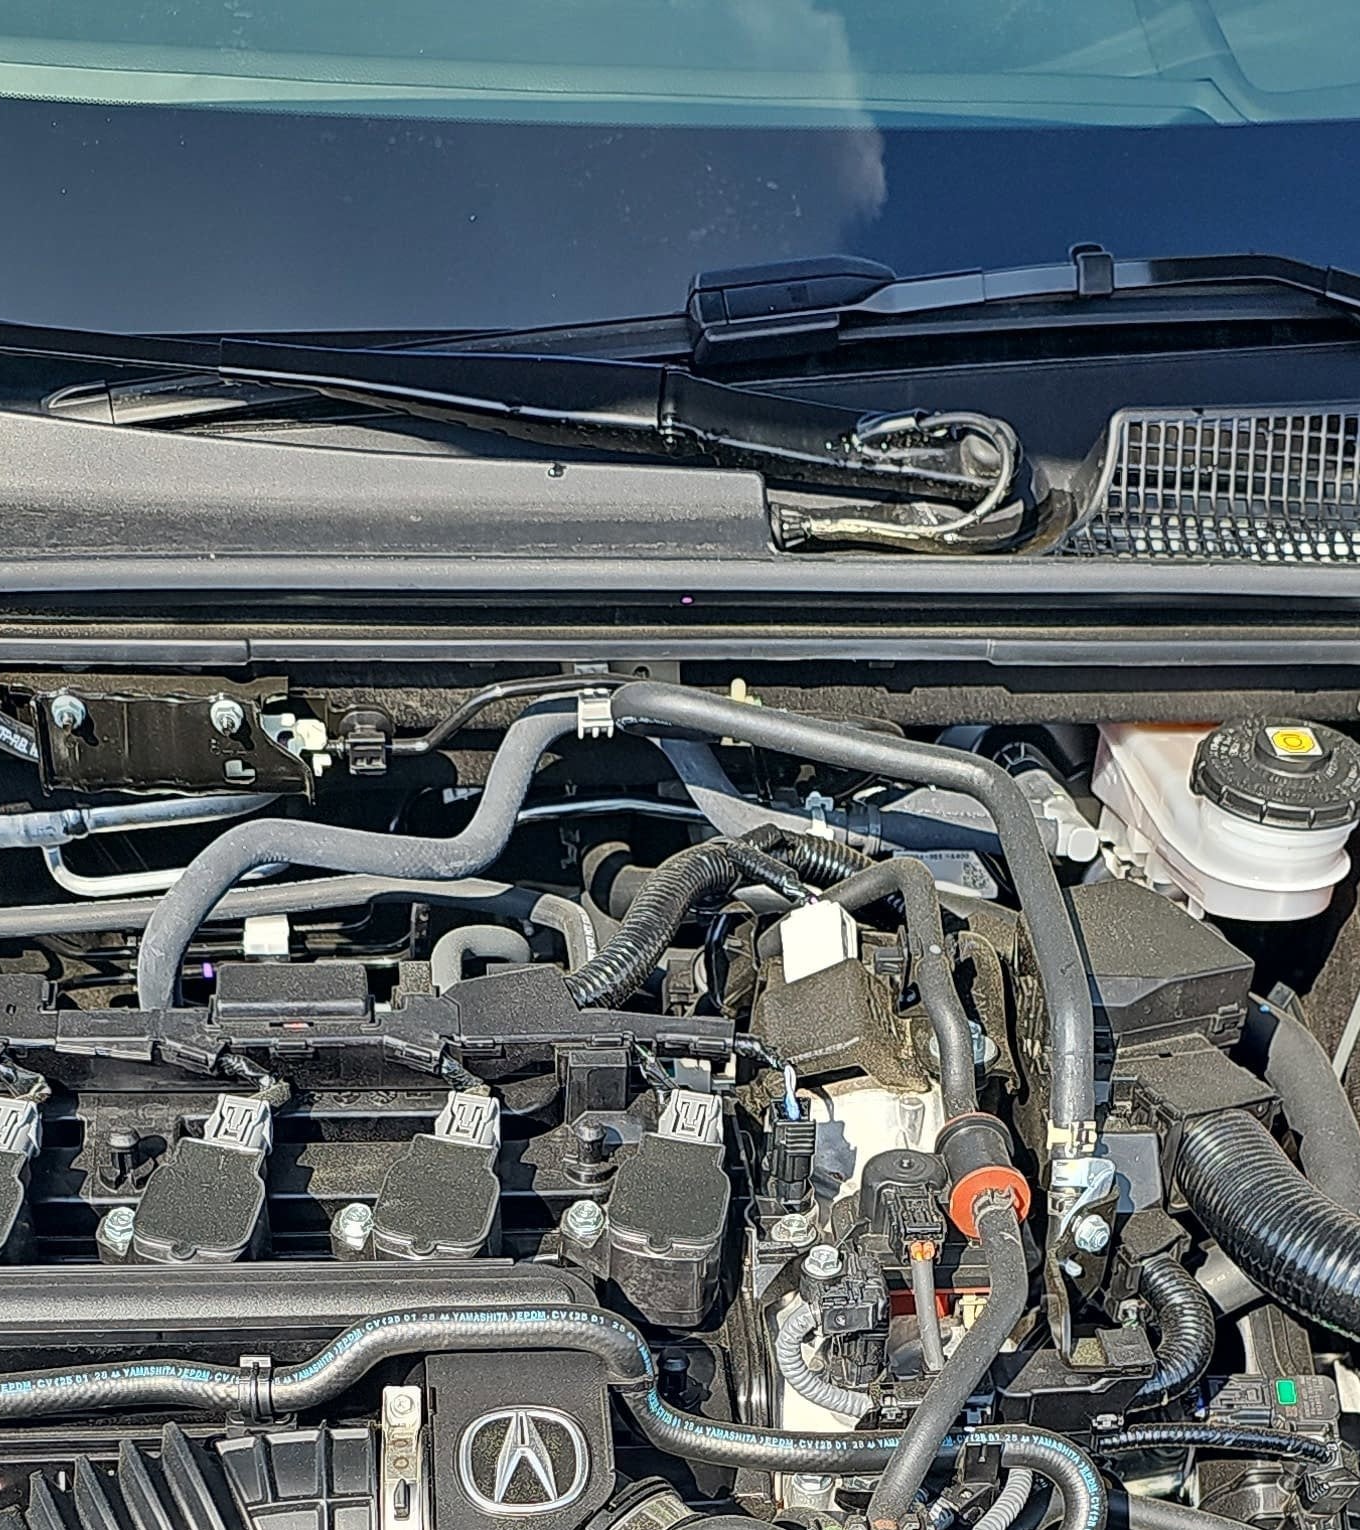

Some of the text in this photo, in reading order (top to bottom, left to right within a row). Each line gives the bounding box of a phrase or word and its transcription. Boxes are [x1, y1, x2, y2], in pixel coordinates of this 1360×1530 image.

[292, 1352, 335, 1383] YAMASHITA
[452, 1311, 508, 1322] YAMASHITA
[122, 1366, 176, 1378] YAMASHITA
[706, 1426, 757, 1445] YAMASHITA
[1032, 1435, 1080, 1463] YAMASHITA
